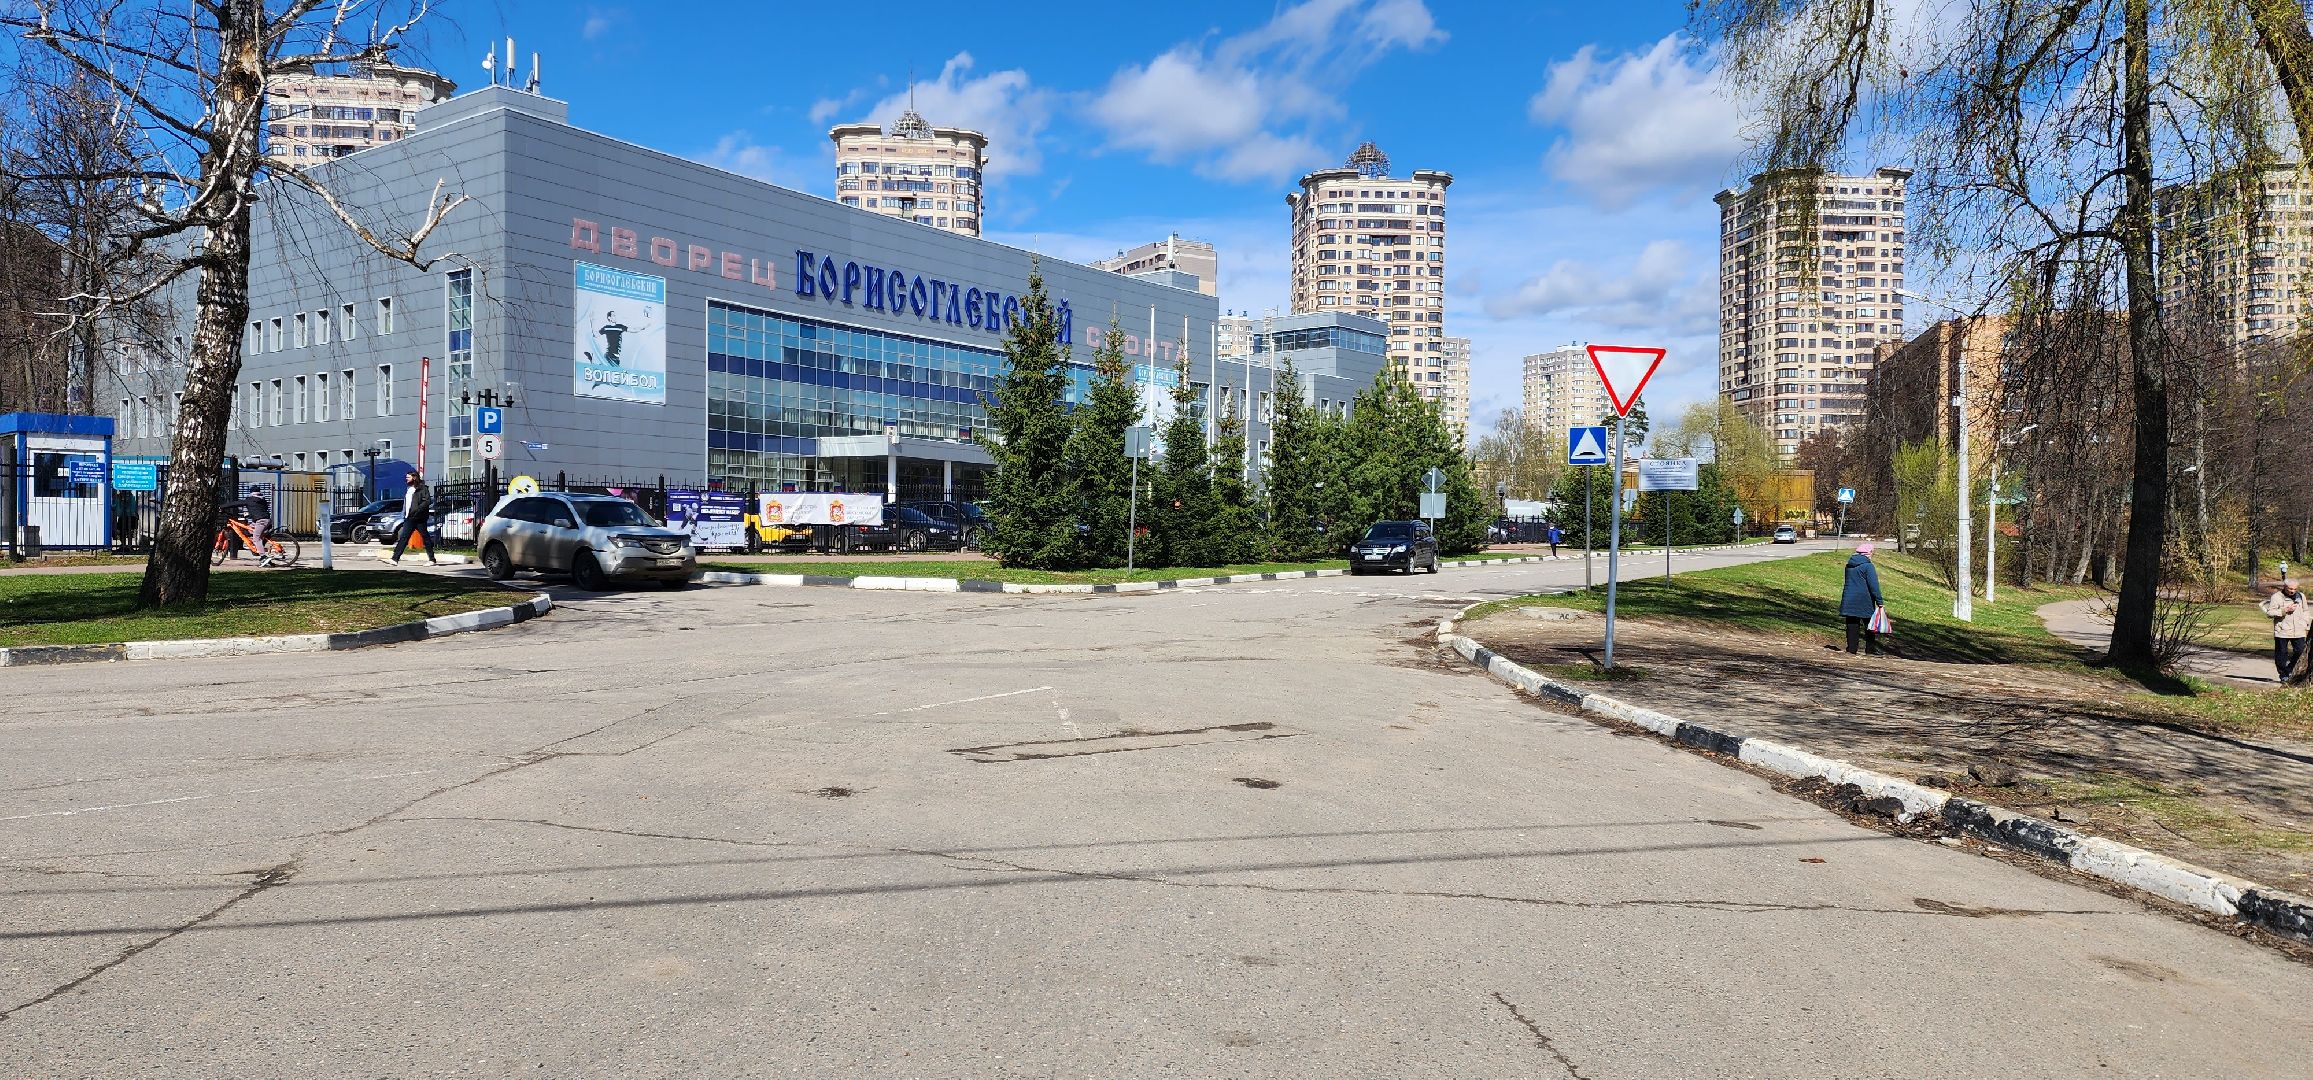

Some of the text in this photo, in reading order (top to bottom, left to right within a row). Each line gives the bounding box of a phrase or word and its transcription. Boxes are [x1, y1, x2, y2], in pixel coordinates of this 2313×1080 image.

[570, 218, 776, 291] ДВОРЕЦ
[795, 249, 1073, 345] БОРИСОГЛЕБСЙ
[584, 367, 657, 390] ВОЛЕЙБОЛ
[484, 411, 498, 429] P
[485, 440, 493, 453] 5
